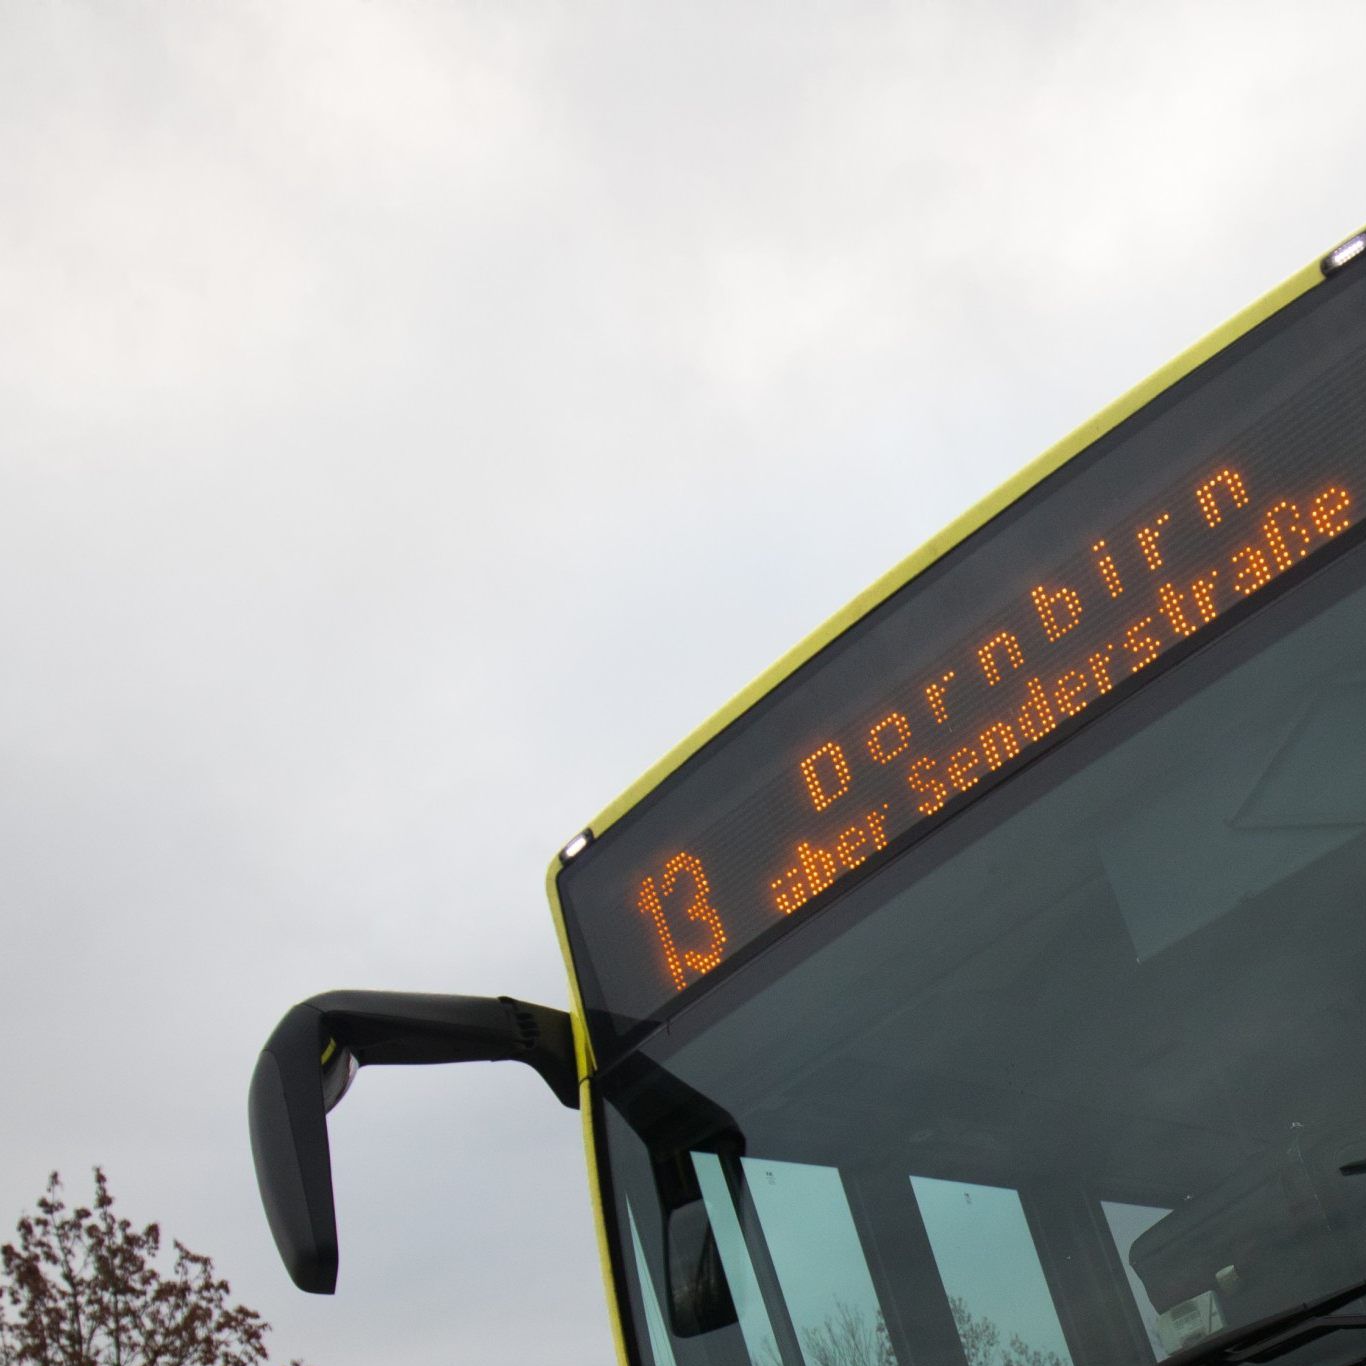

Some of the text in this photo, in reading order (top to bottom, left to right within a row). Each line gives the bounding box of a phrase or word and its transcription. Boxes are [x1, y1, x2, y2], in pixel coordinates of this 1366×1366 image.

[801, 469, 1249, 812] Dornbirn
[908, 487, 1350, 815] Senderstraße
[637, 852, 727, 991] 13
